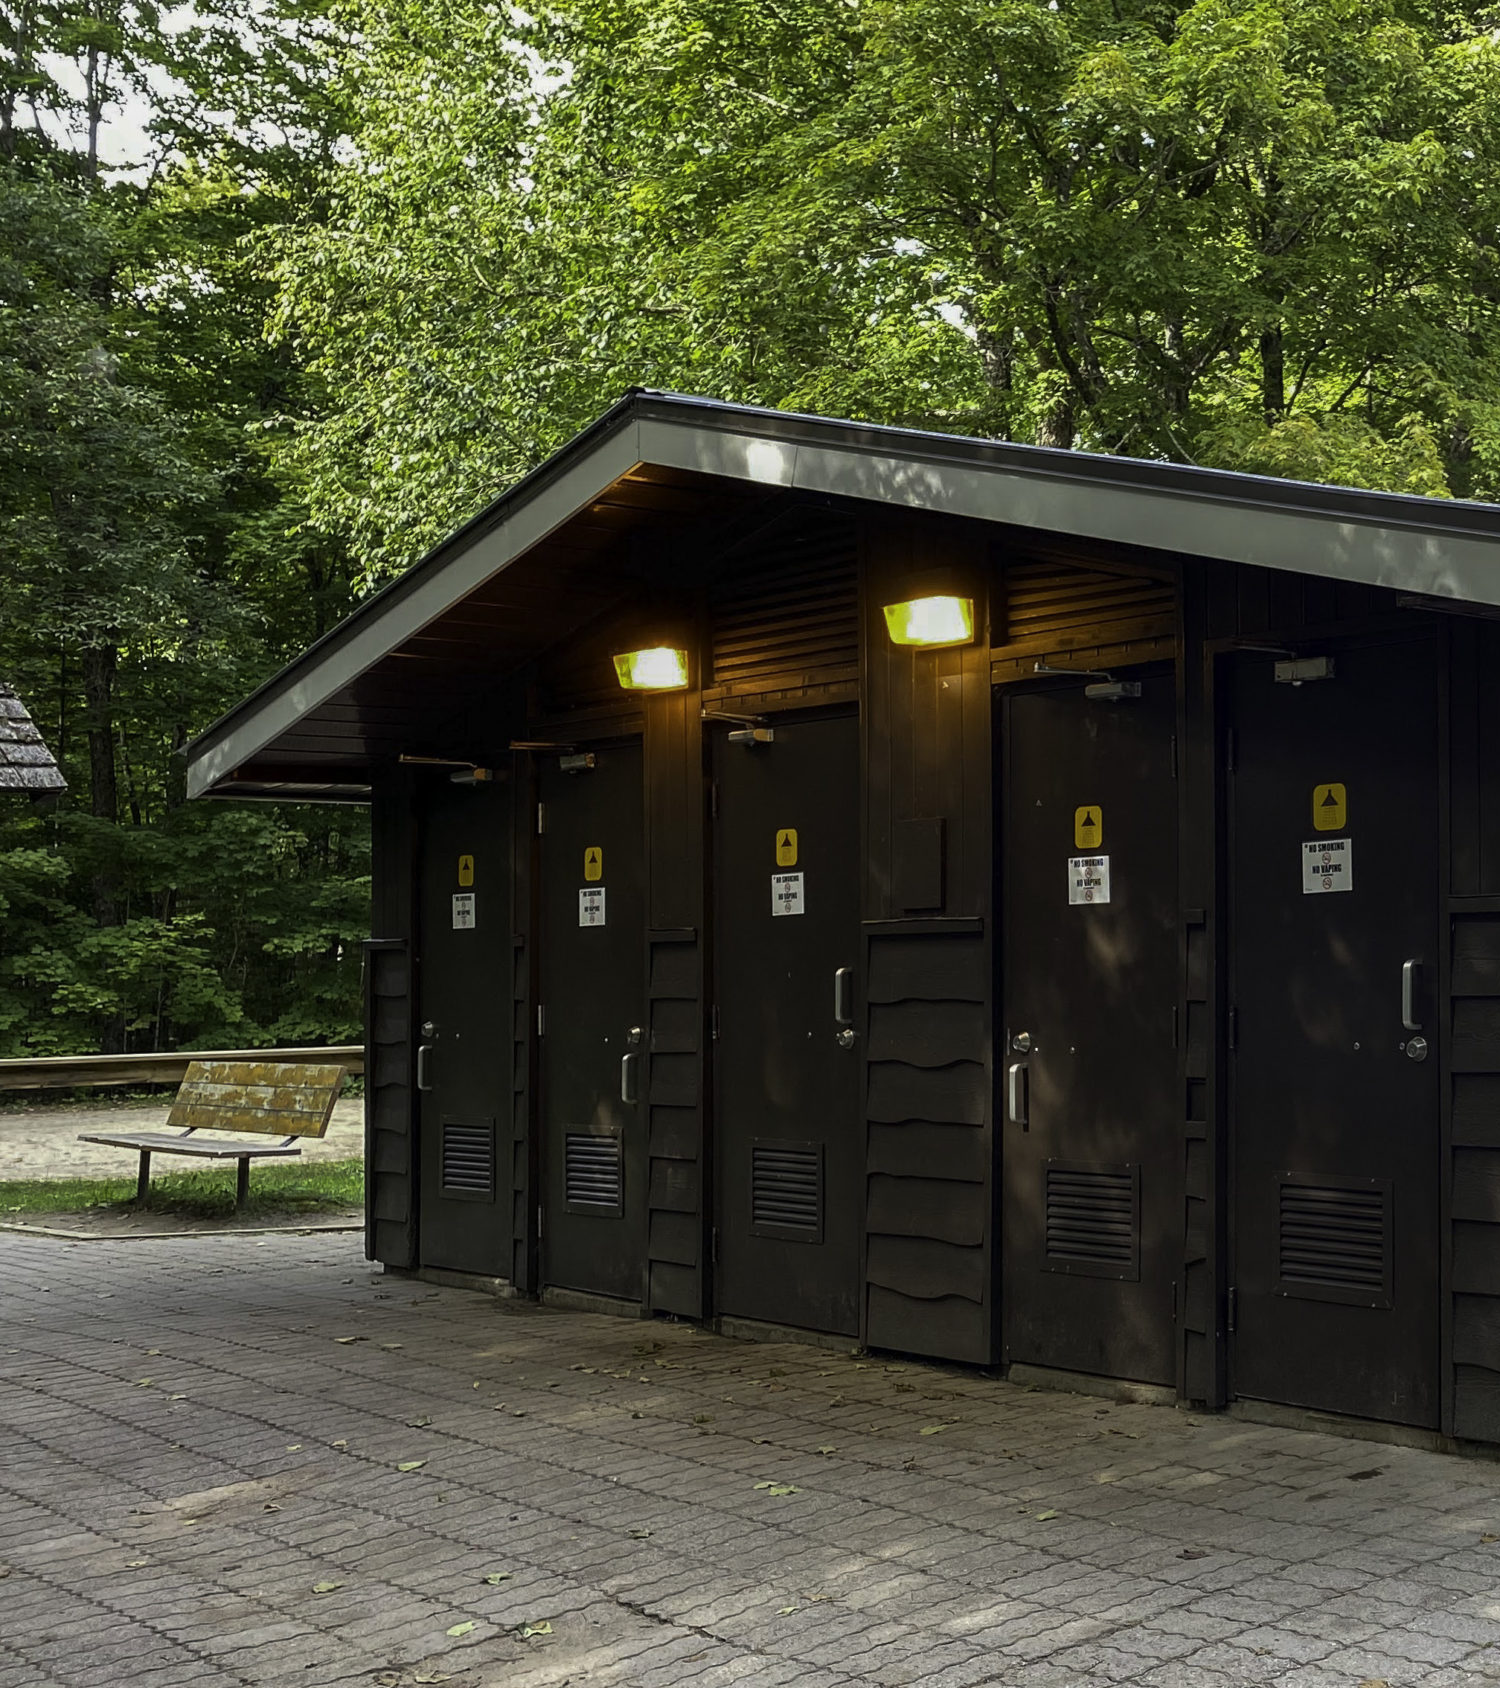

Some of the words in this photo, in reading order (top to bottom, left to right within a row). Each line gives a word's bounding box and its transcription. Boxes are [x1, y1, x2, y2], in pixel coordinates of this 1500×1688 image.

[1309, 844, 1317, 853] NO
[1318, 842, 1344, 852] SMOKING
[1321, 864, 1342, 873] VAPING
